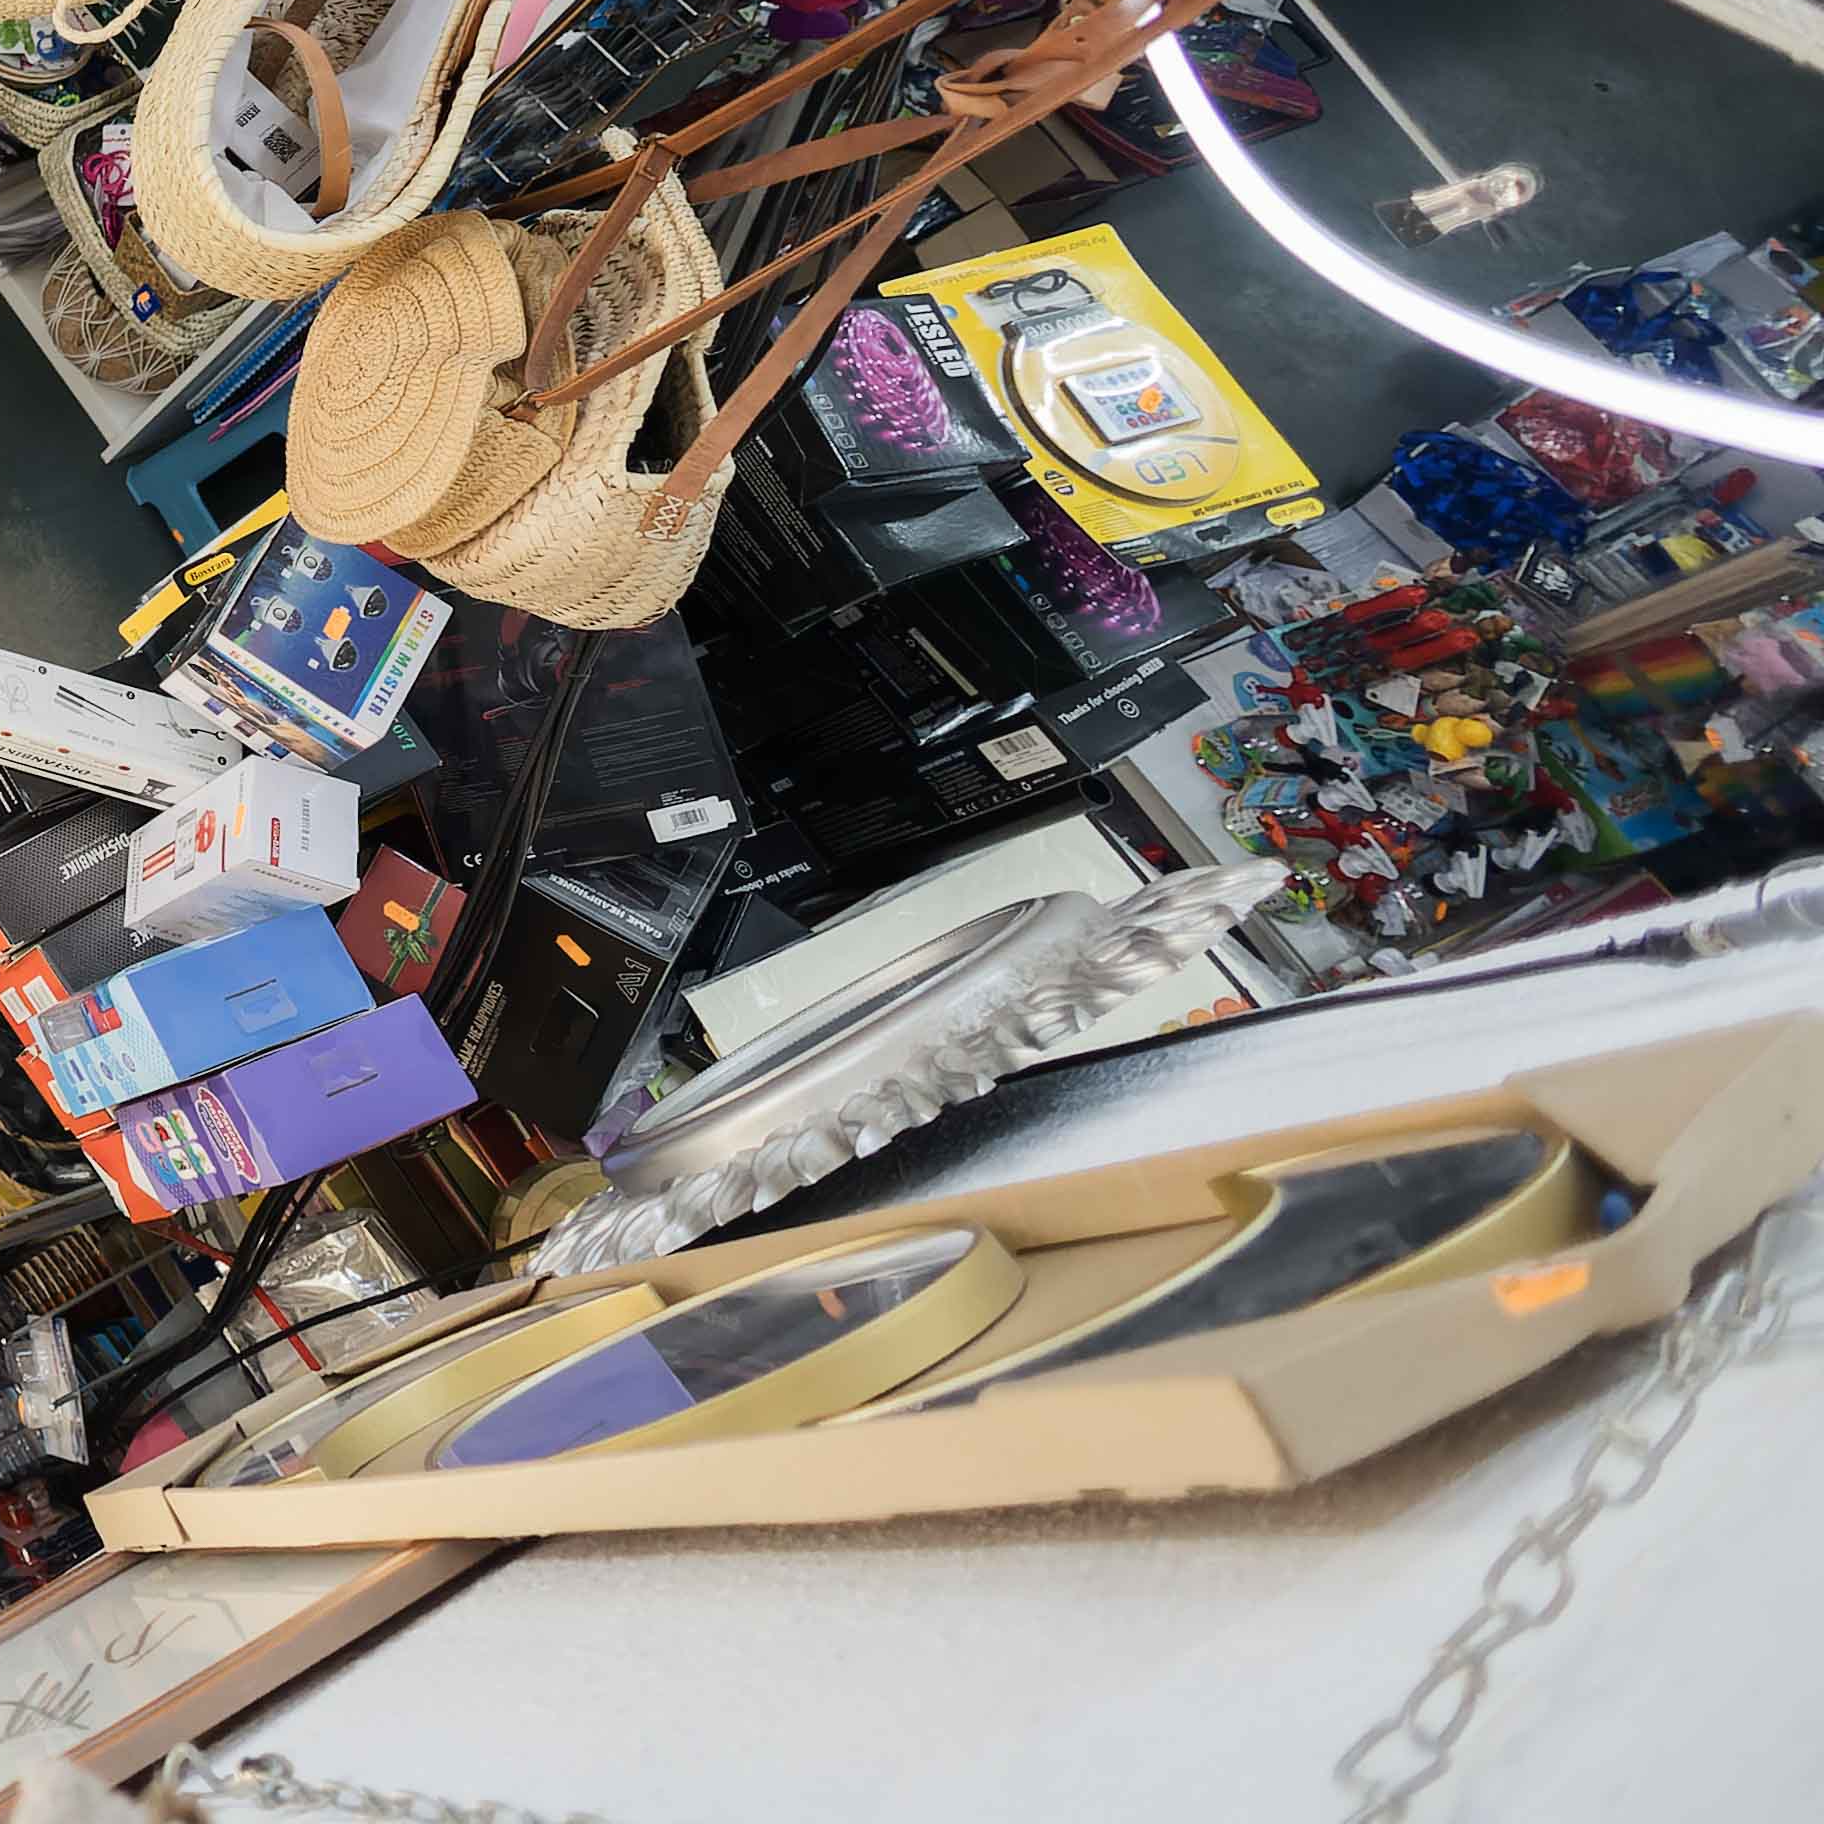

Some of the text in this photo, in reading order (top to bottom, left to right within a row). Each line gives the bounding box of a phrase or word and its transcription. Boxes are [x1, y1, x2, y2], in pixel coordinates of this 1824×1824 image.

[904, 302, 970, 379] JESLED
[1134, 447, 1209, 486] LED
[188, 555, 234, 584] Bossram
[367, 609, 435, 718] STAR MASTER
[228, 649, 356, 737] STAR MASTER
[1056, 701, 1092, 726] Thanks
[1087, 694, 1105, 708] for
[1102, 673, 1144, 700] choosing
[59, 831, 131, 883] DISTANBIKE
[550, 873, 626, 923] HEADPHONES
[459, 980, 505, 1071] GAME HEADPHONES
